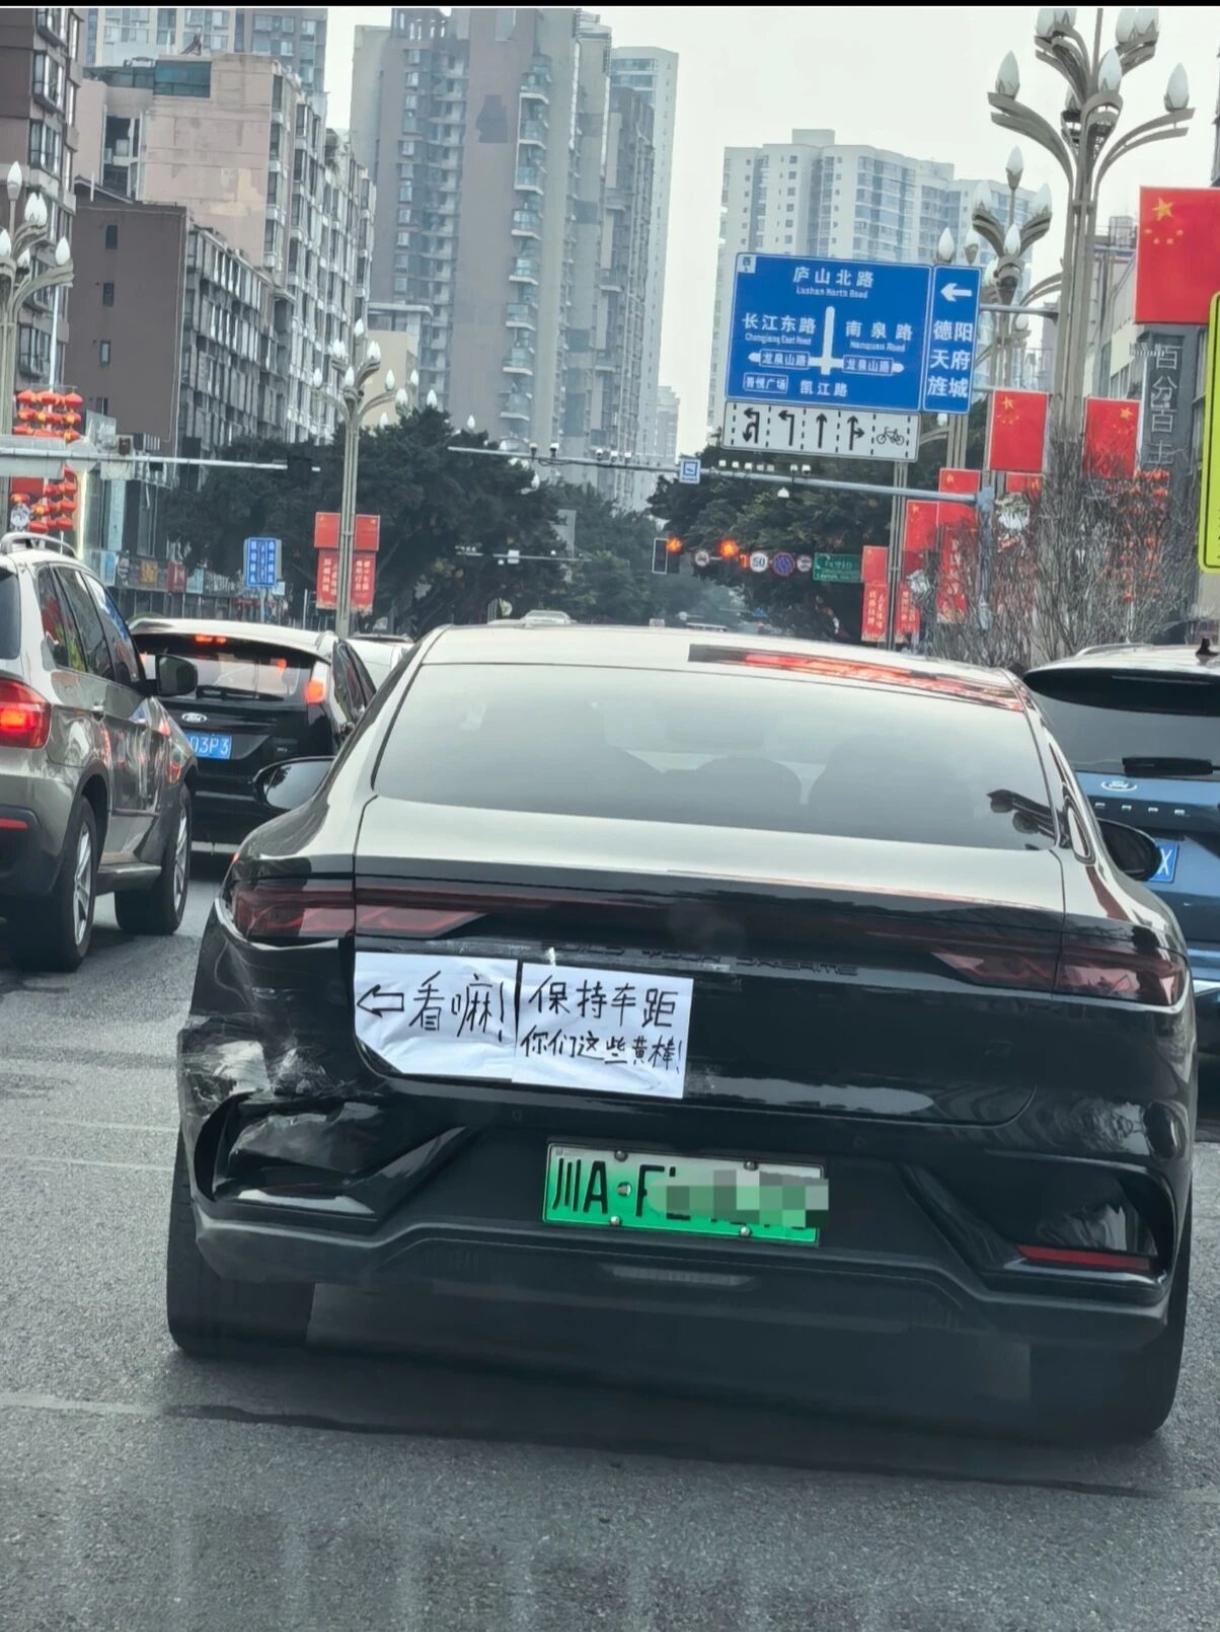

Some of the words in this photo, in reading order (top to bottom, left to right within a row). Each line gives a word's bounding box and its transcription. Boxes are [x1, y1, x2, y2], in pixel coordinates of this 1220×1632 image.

[793, 266, 874, 288] 庐山北路
[742, 312, 817, 335] 长江东路
[846, 320, 913, 342] 南泉路
[933, 320, 974, 343] 德阳
[930, 349, 971, 371] 天府
[528, 975, 679, 1028] 保持车距
